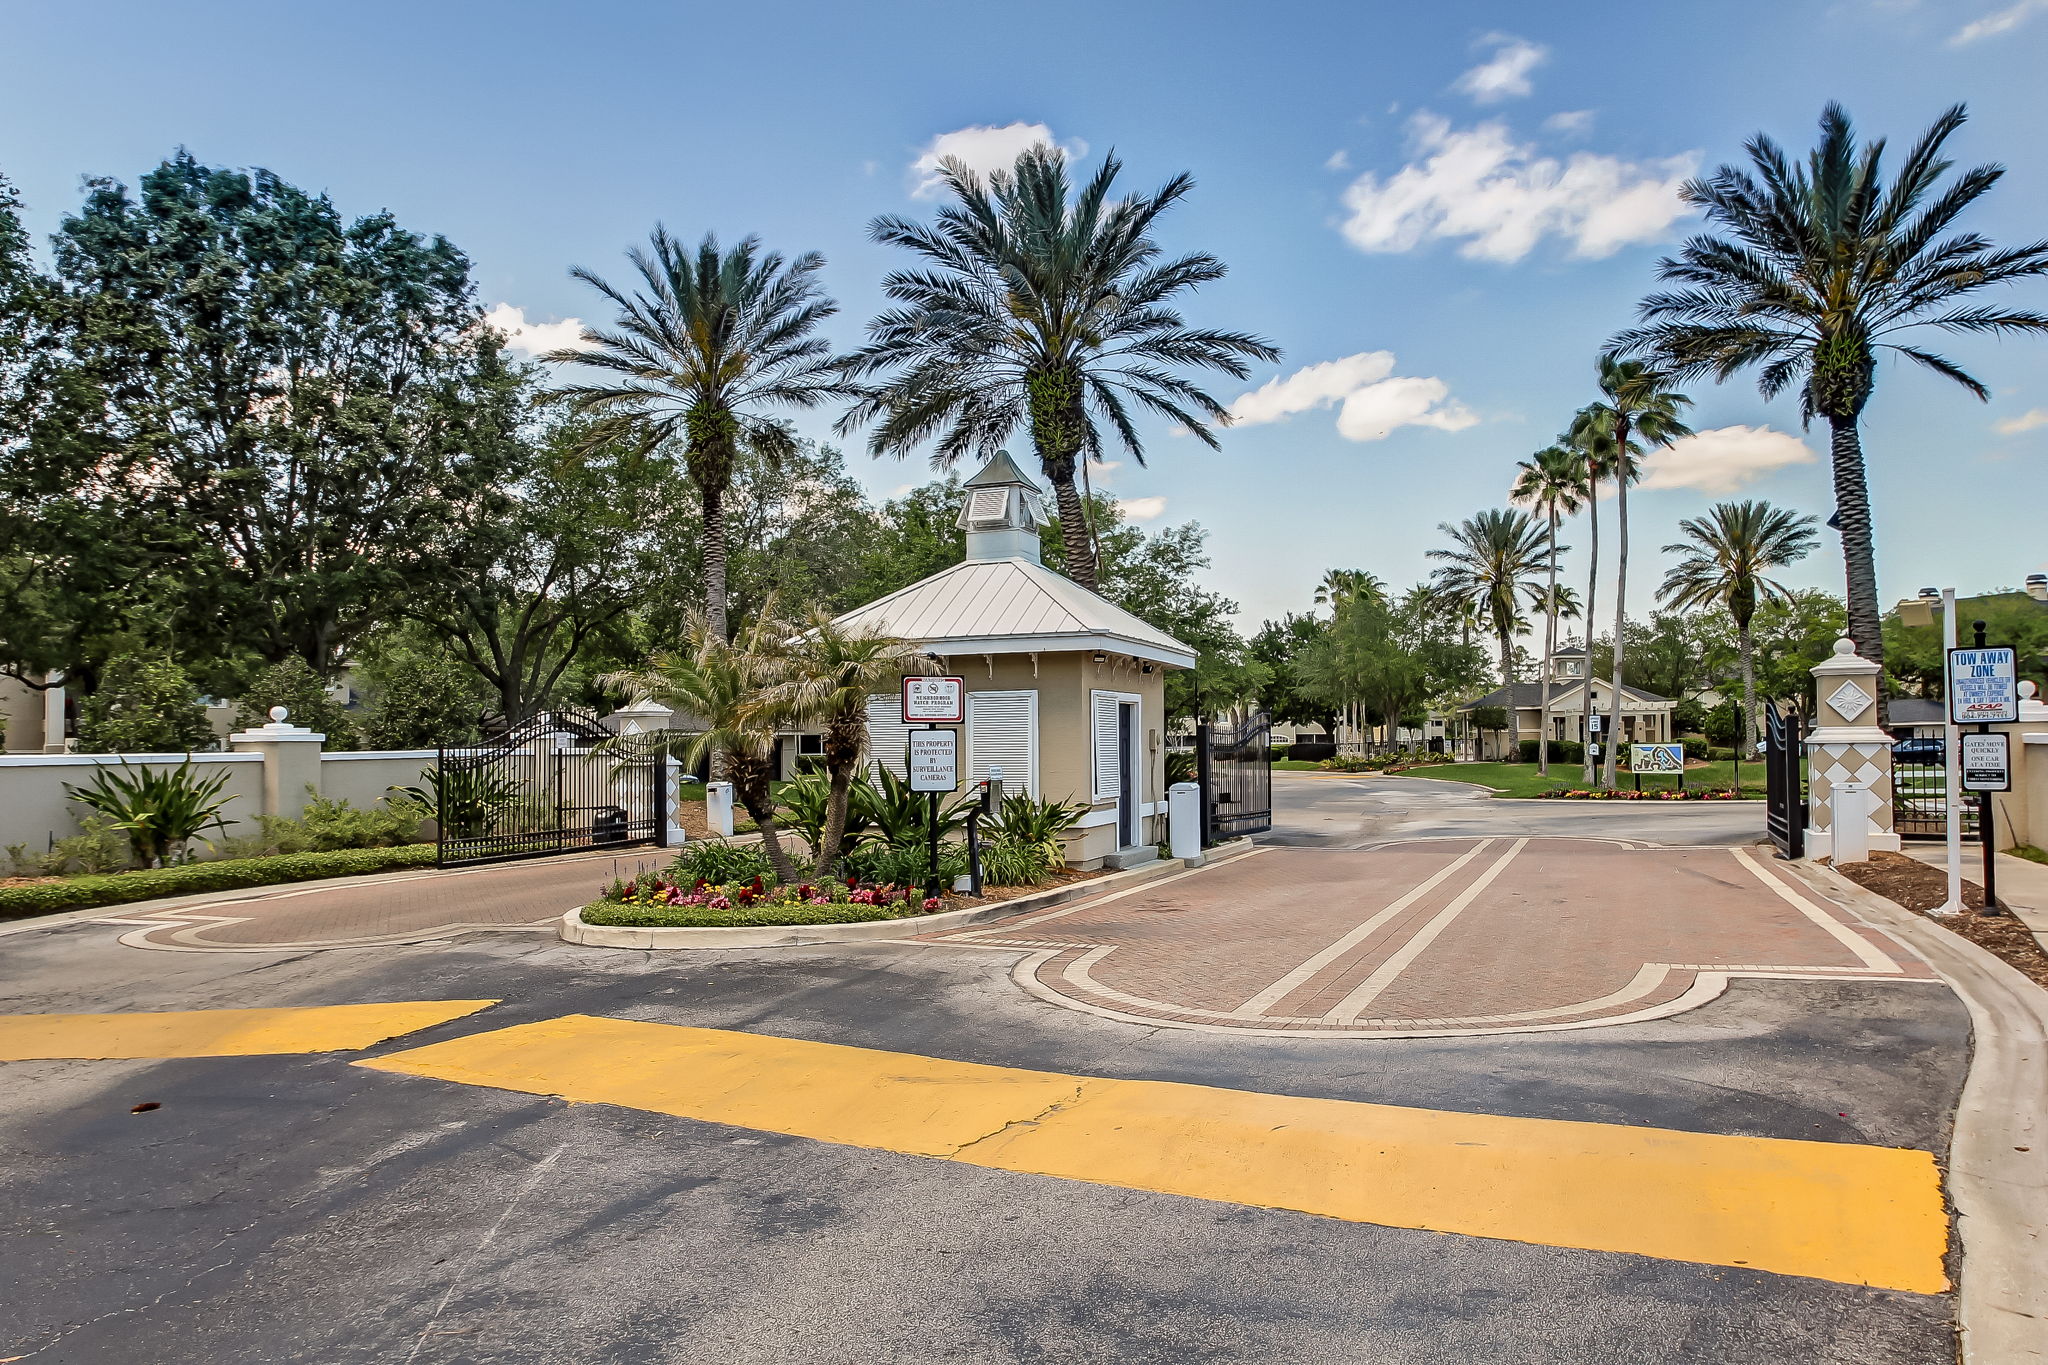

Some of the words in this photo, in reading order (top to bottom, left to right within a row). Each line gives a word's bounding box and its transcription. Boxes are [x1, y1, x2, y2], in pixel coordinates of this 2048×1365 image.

[1955, 653, 1976, 665] TOW
[1980, 652, 2009, 664] AWAY
[1971, 665, 1995, 677] ZONE
